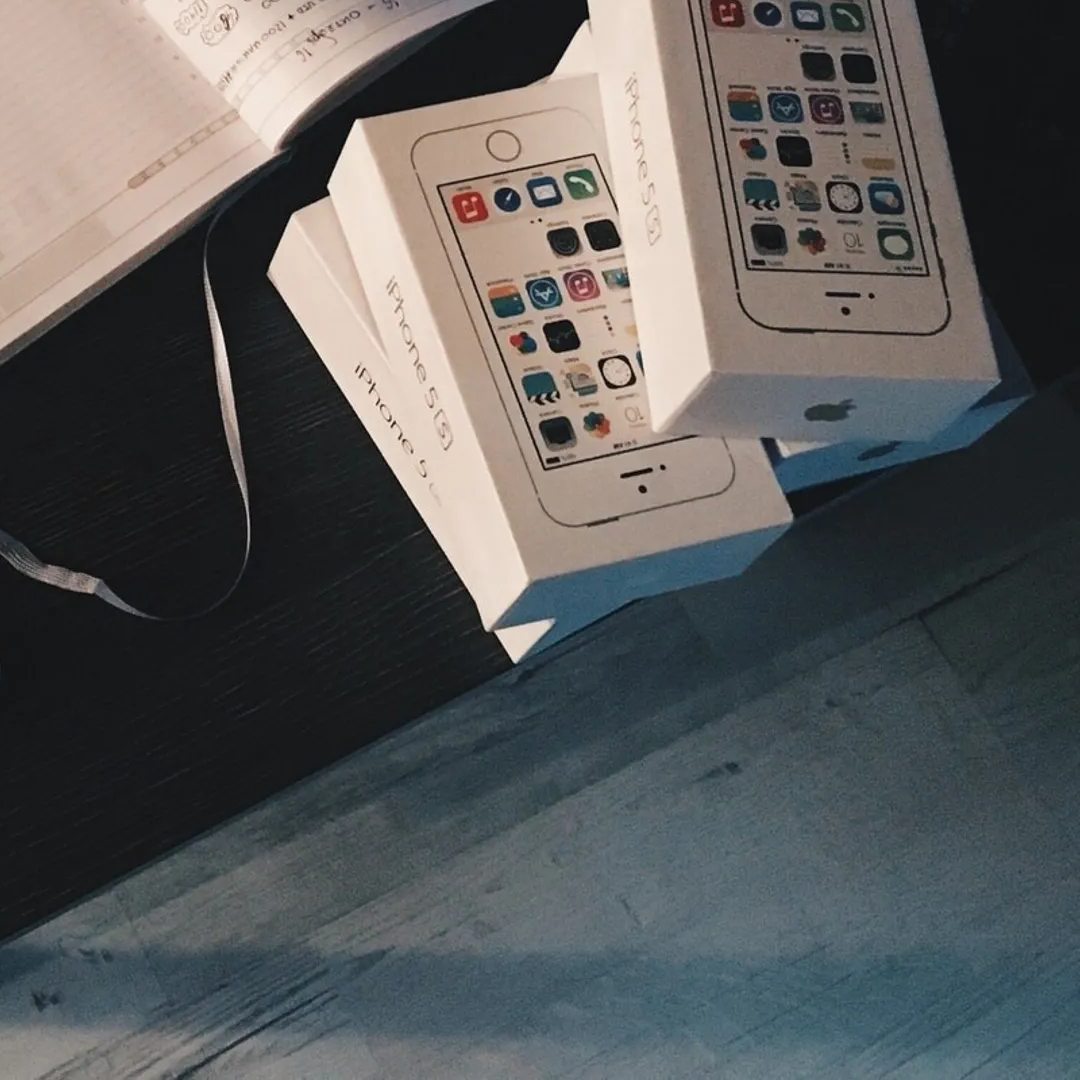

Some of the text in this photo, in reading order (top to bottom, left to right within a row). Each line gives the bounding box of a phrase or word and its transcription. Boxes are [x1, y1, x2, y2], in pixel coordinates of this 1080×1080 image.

[625, 72, 648, 181] iPhone
[843, 233, 863, 247] 10
[385, 275, 427, 385] iPhone
[354, 361, 415, 455] iPhone
[623, 405, 645, 422] 10
